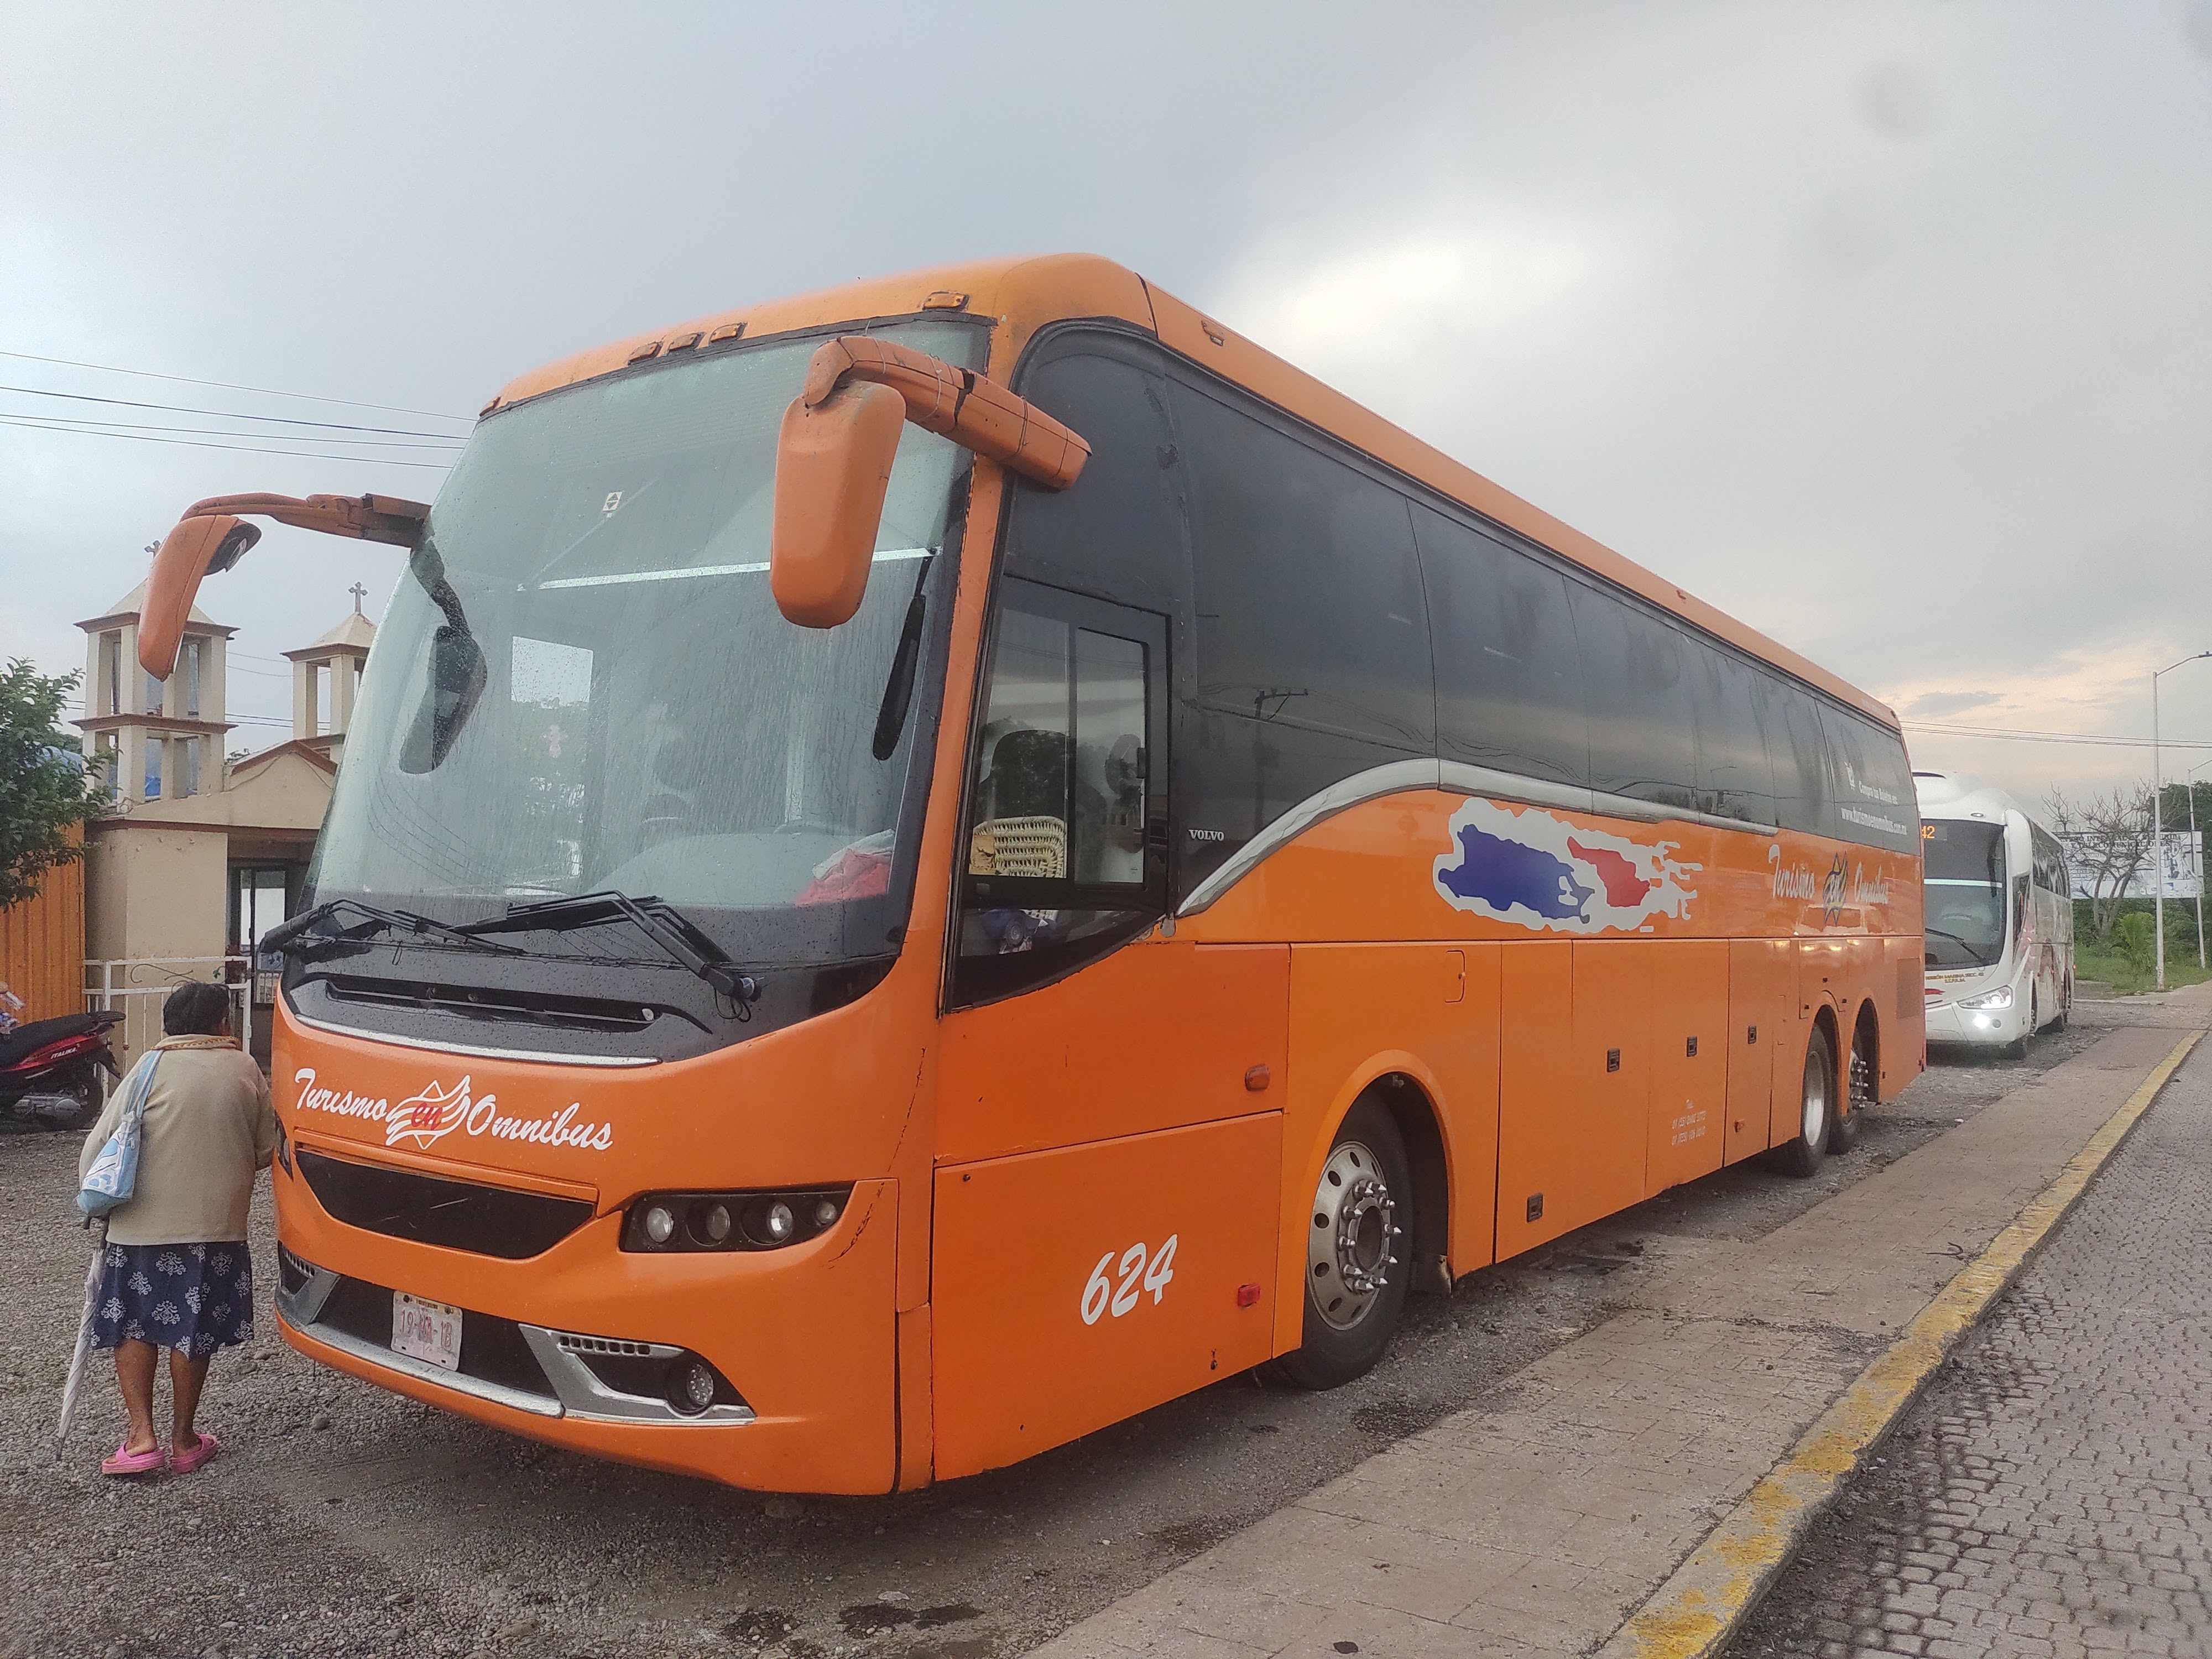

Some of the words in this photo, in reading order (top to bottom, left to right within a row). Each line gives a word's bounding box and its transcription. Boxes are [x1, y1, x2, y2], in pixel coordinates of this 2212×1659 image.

[1188, 830, 1224, 841] VOLVO
[50, 1047, 77, 1059] ITALIKA
[295, 1068, 387, 1118] Turismo
[411, 1101, 443, 1131] en
[467, 1094, 613, 1150] Omnibus
[1080, 1234, 1178, 1326] 624
